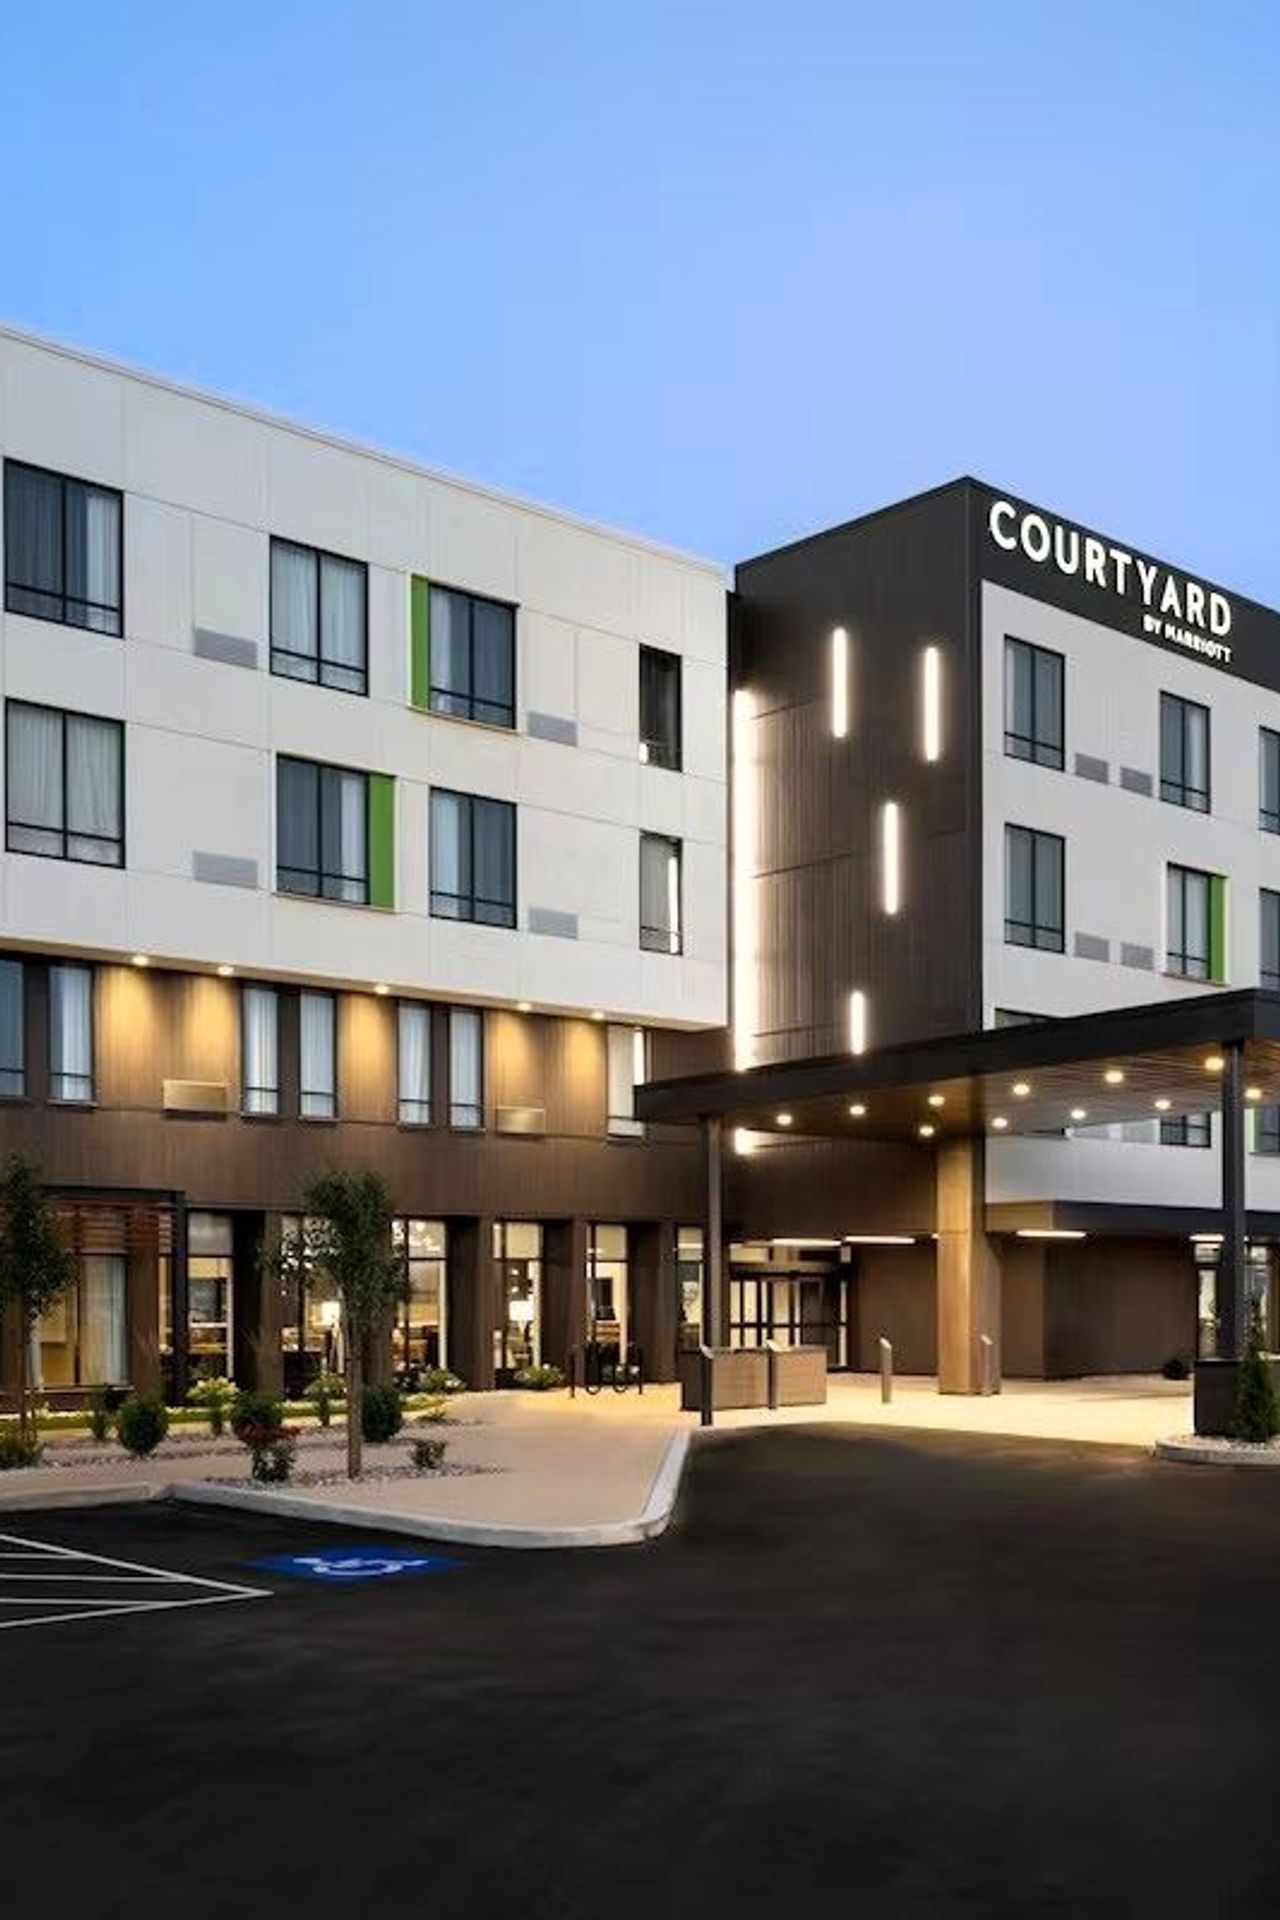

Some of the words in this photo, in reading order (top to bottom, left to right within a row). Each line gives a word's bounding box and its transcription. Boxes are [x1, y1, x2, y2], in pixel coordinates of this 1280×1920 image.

[989, 501, 1232, 637] COURTYARD
[1143, 614, 1163, 633] BY
[1165, 624, 1232, 662] MARRIOTT
